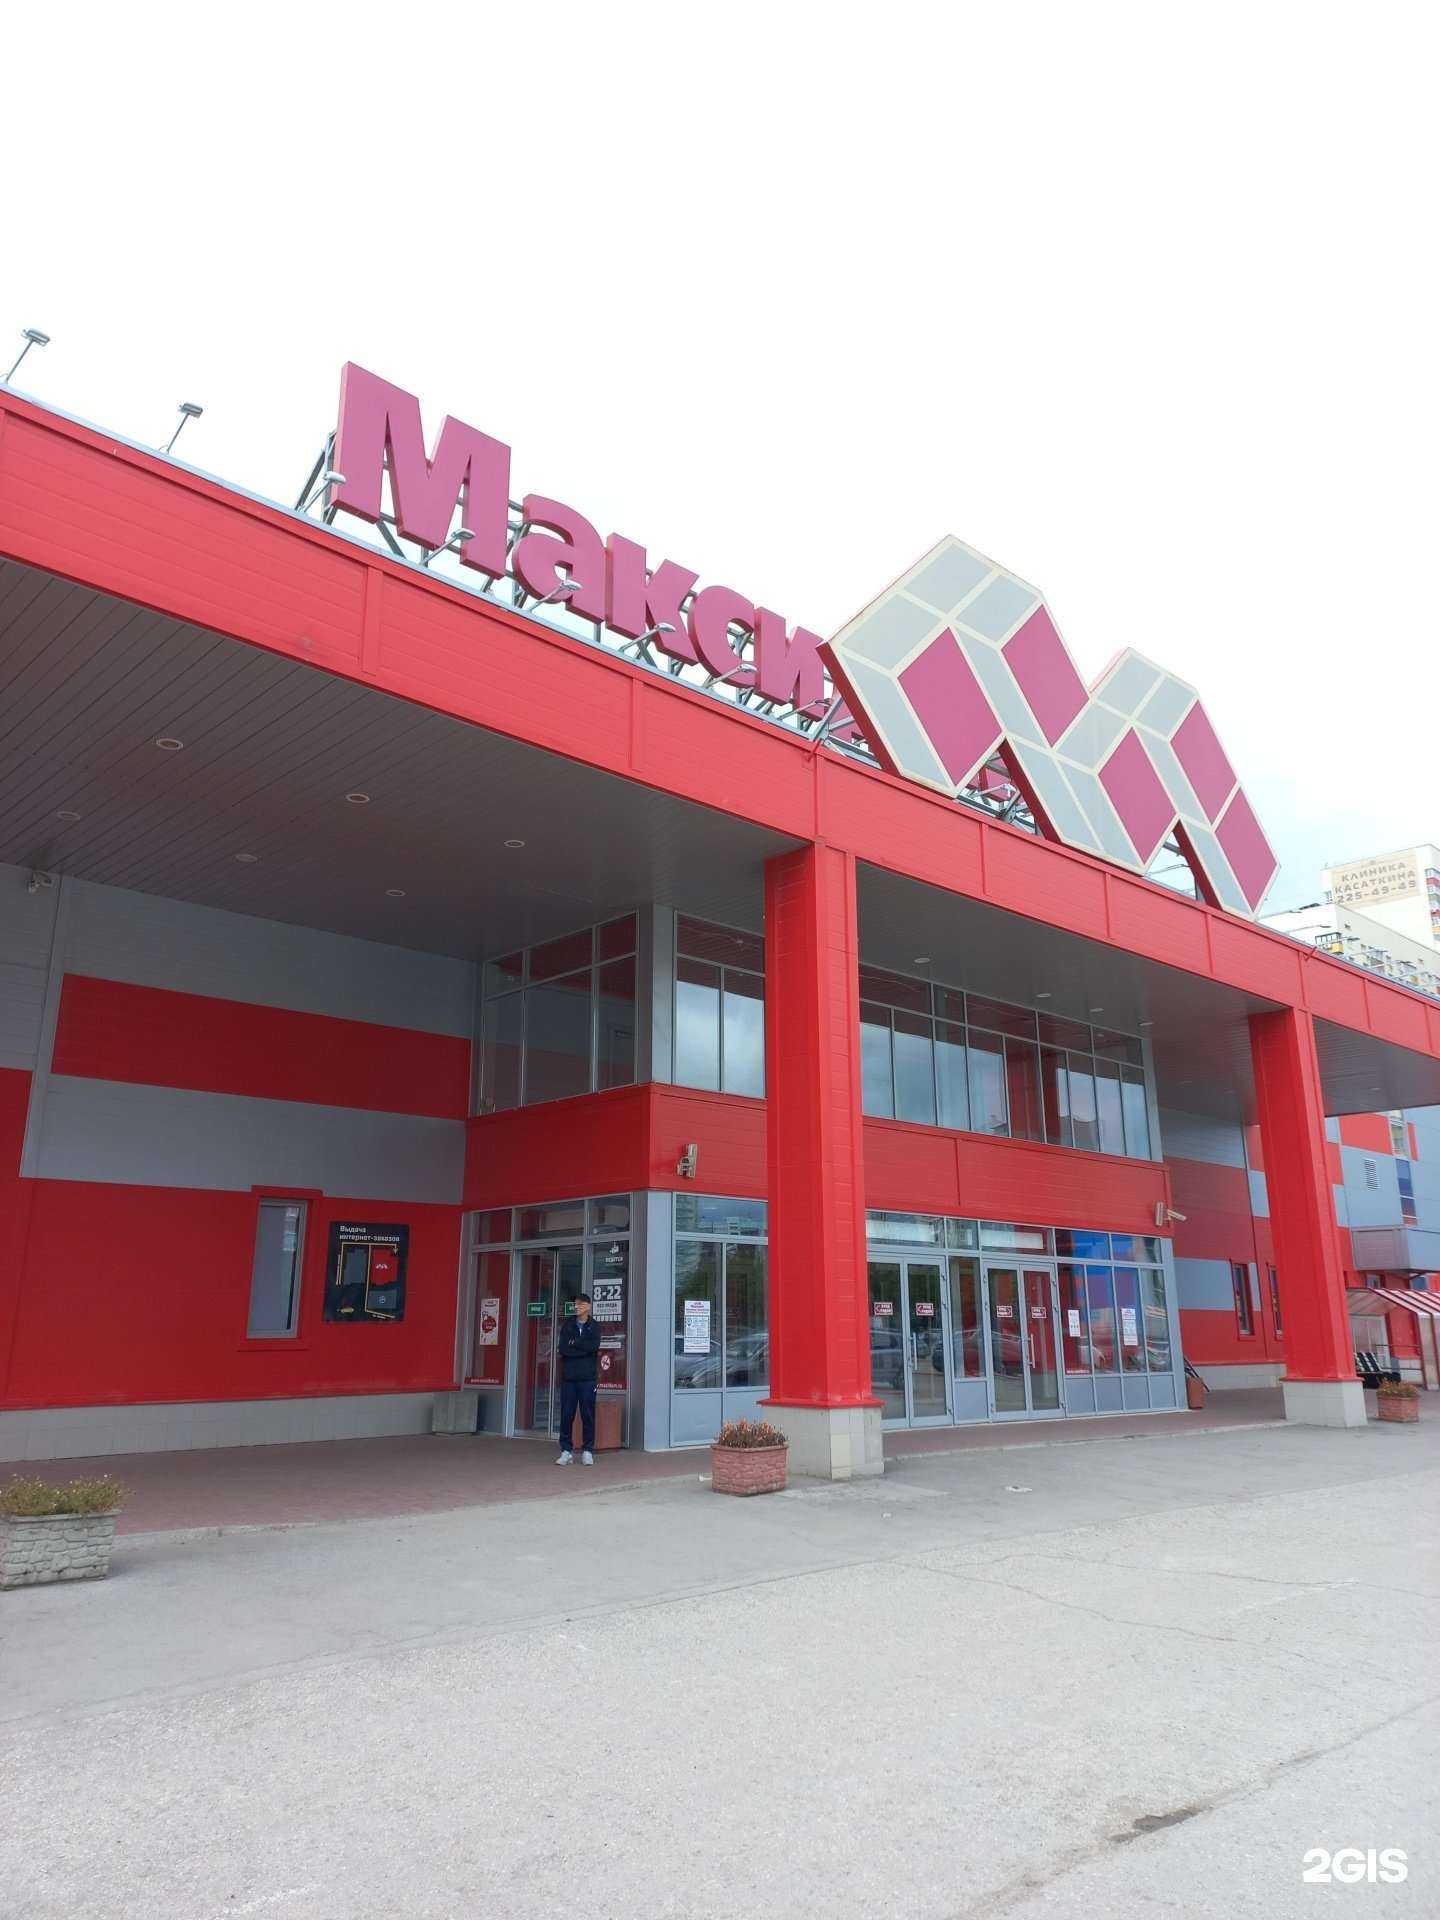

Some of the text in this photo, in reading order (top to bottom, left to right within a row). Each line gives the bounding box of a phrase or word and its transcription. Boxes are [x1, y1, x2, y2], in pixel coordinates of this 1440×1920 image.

[1341, 862, 1406, 882] КЛИНИКА
[1334, 870, 1416, 894] КАСАТКИНА
[340, 1225, 367, 1233] Выдача
[339, 1234, 400, 1242] интернет-заказов
[593, 1285, 621, 1300] 8-22
